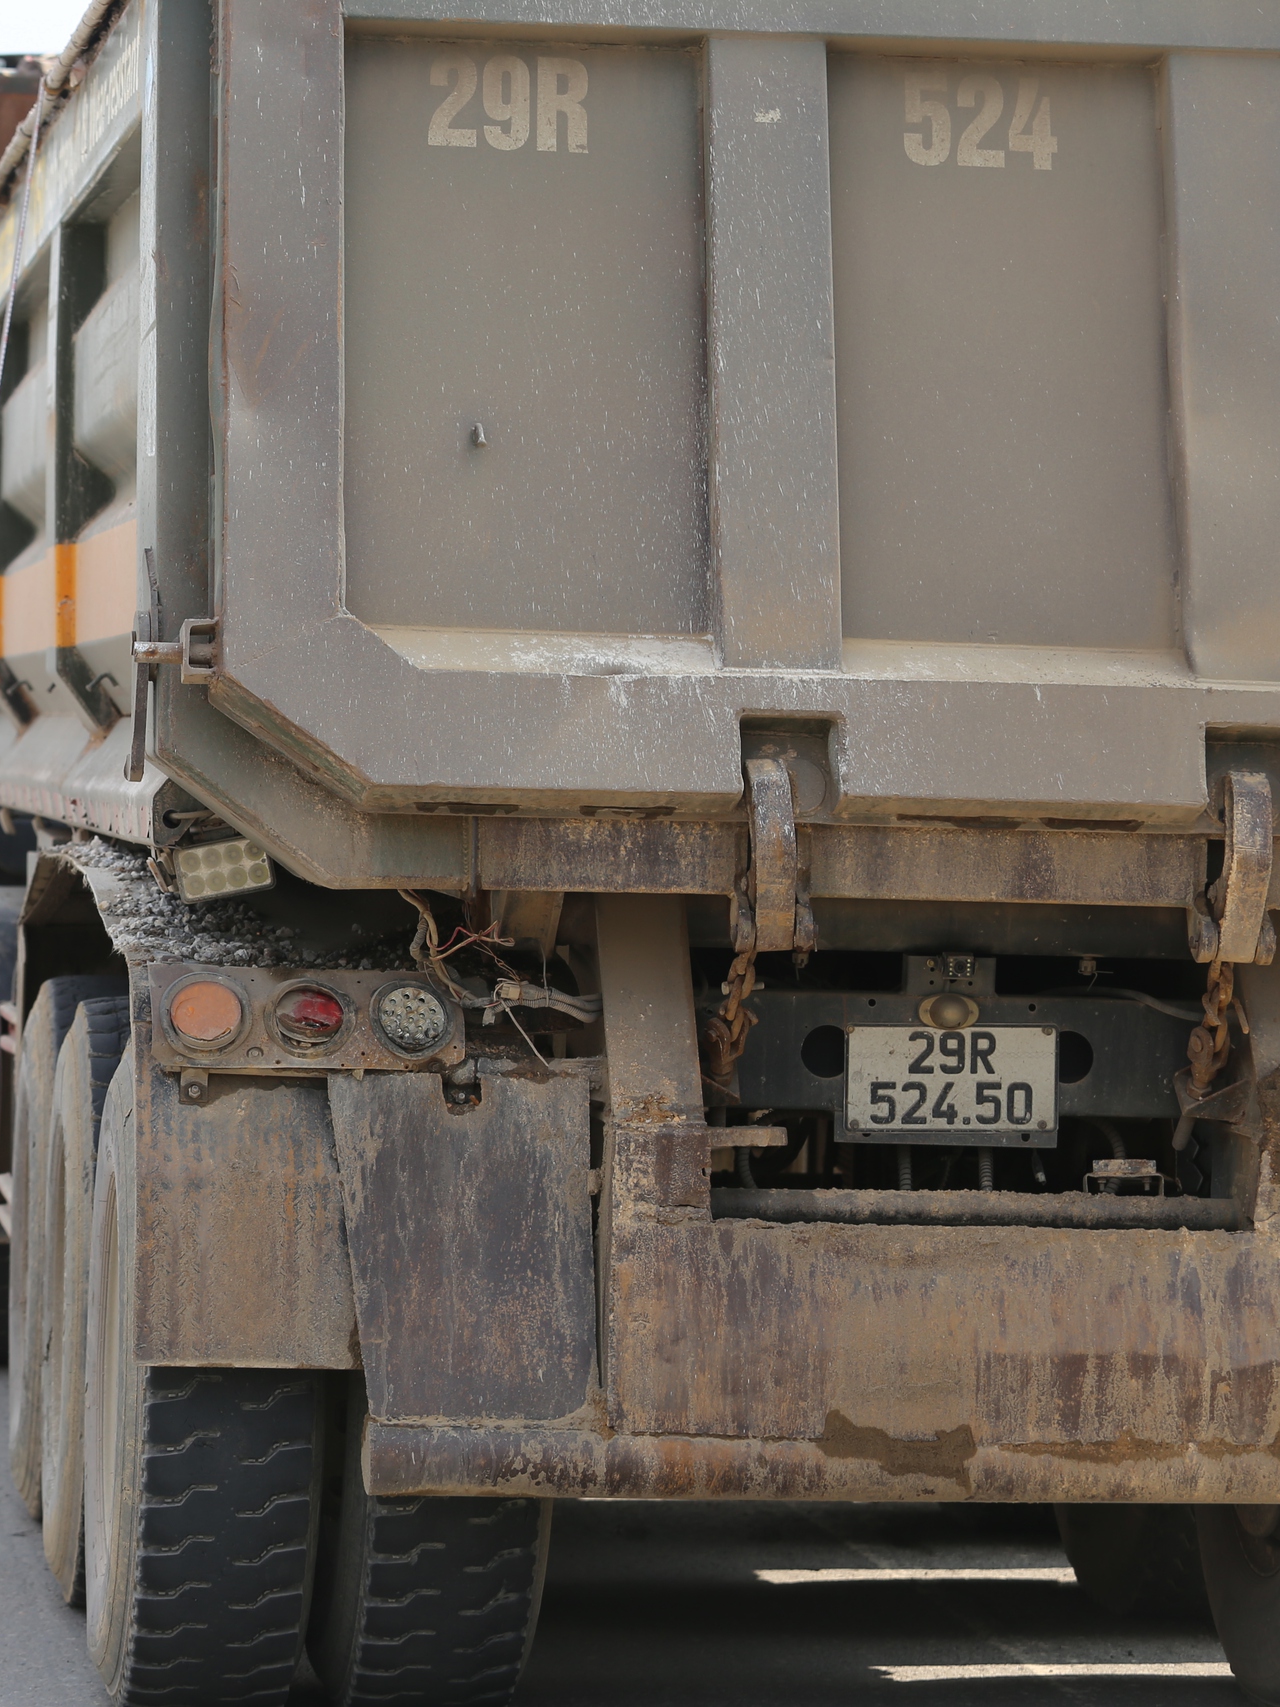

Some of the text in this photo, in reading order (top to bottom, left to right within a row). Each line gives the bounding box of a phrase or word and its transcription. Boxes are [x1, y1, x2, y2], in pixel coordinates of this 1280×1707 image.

[427, 54, 590, 154] 29R
[903, 71, 1059, 171] 524
[907, 1030, 997, 1075] 29R
[869, 1080, 1034, 1126] 524.50
